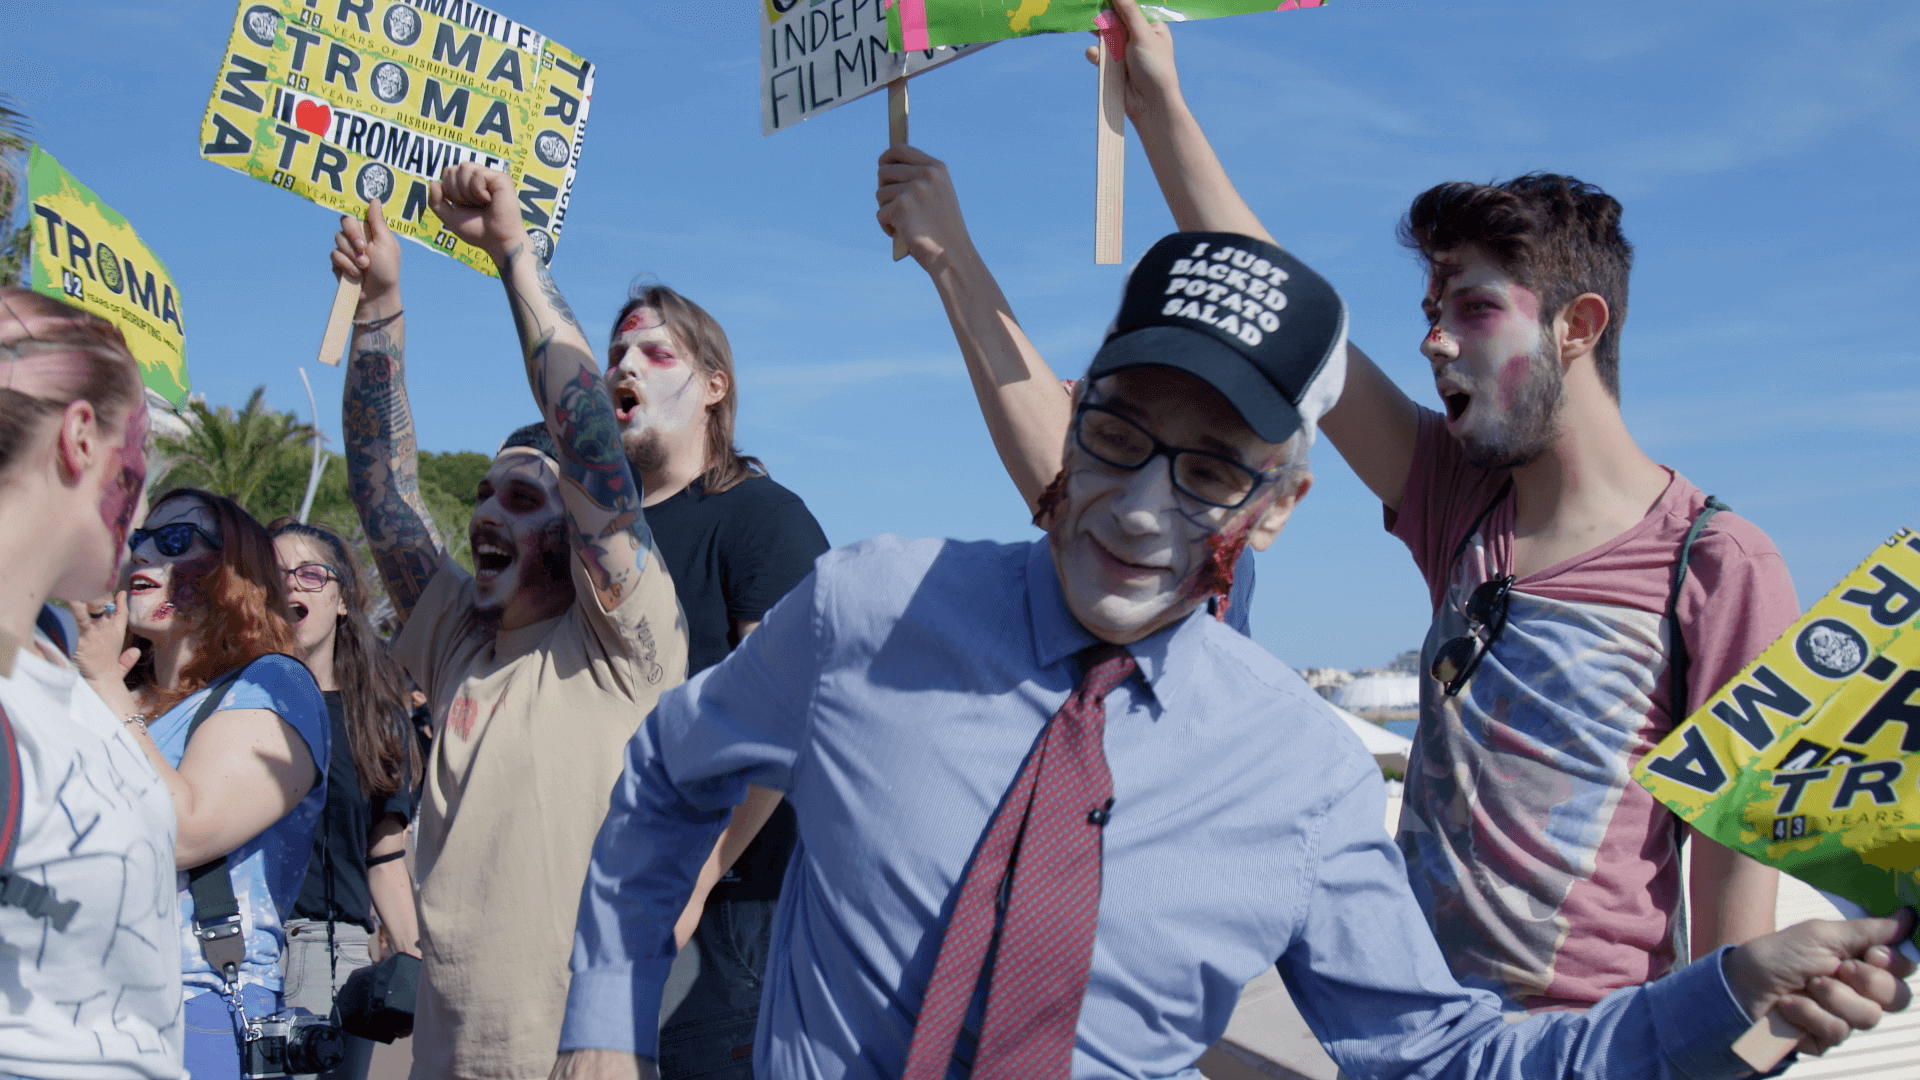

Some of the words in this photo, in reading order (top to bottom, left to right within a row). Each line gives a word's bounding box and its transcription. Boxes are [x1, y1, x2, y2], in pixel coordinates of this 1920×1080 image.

[301, 9, 322, 28] 43
[333, 24, 374, 48] YEARS
[381, 45, 399, 57] OF
[407, 54, 474, 87] DISRUPTING
[480, 82, 520, 103] MEDIA
[305, 0, 524, 92] ROMA
[203, 5, 287, 155] OMA
[285, 26, 514, 144] TROMA
[531, 79, 547, 118] YEARS
[288, 72, 309, 91] 43
[321, 85, 362, 108] YEARS
[371, 104, 388, 115] OF
[396, 111, 462, 141] DISRUPTING
[470, 136, 510, 156] MEDIA
[526, 124, 535, 140] OF
[518, 57, 591, 228] TROM
[272, 171, 296, 190] 43
[307, 186, 346, 209] YEARS
[33, 203, 184, 336] TROMA
[435, 231, 457, 251] 43
[468, 247, 494, 265] YEA
[1191, 242, 1211, 257] I
[1211, 246, 1290, 287] JUST
[61, 266, 84, 302] 42
[1164, 277, 1281, 333] POTATO
[1168, 258, 1288, 312] BACKED
[1161, 298, 1263, 347] SALAD
[1647, 537, 1920, 793] ROMA
[1772, 760, 1920, 815] TR
[1773, 816, 1805, 840] 43
